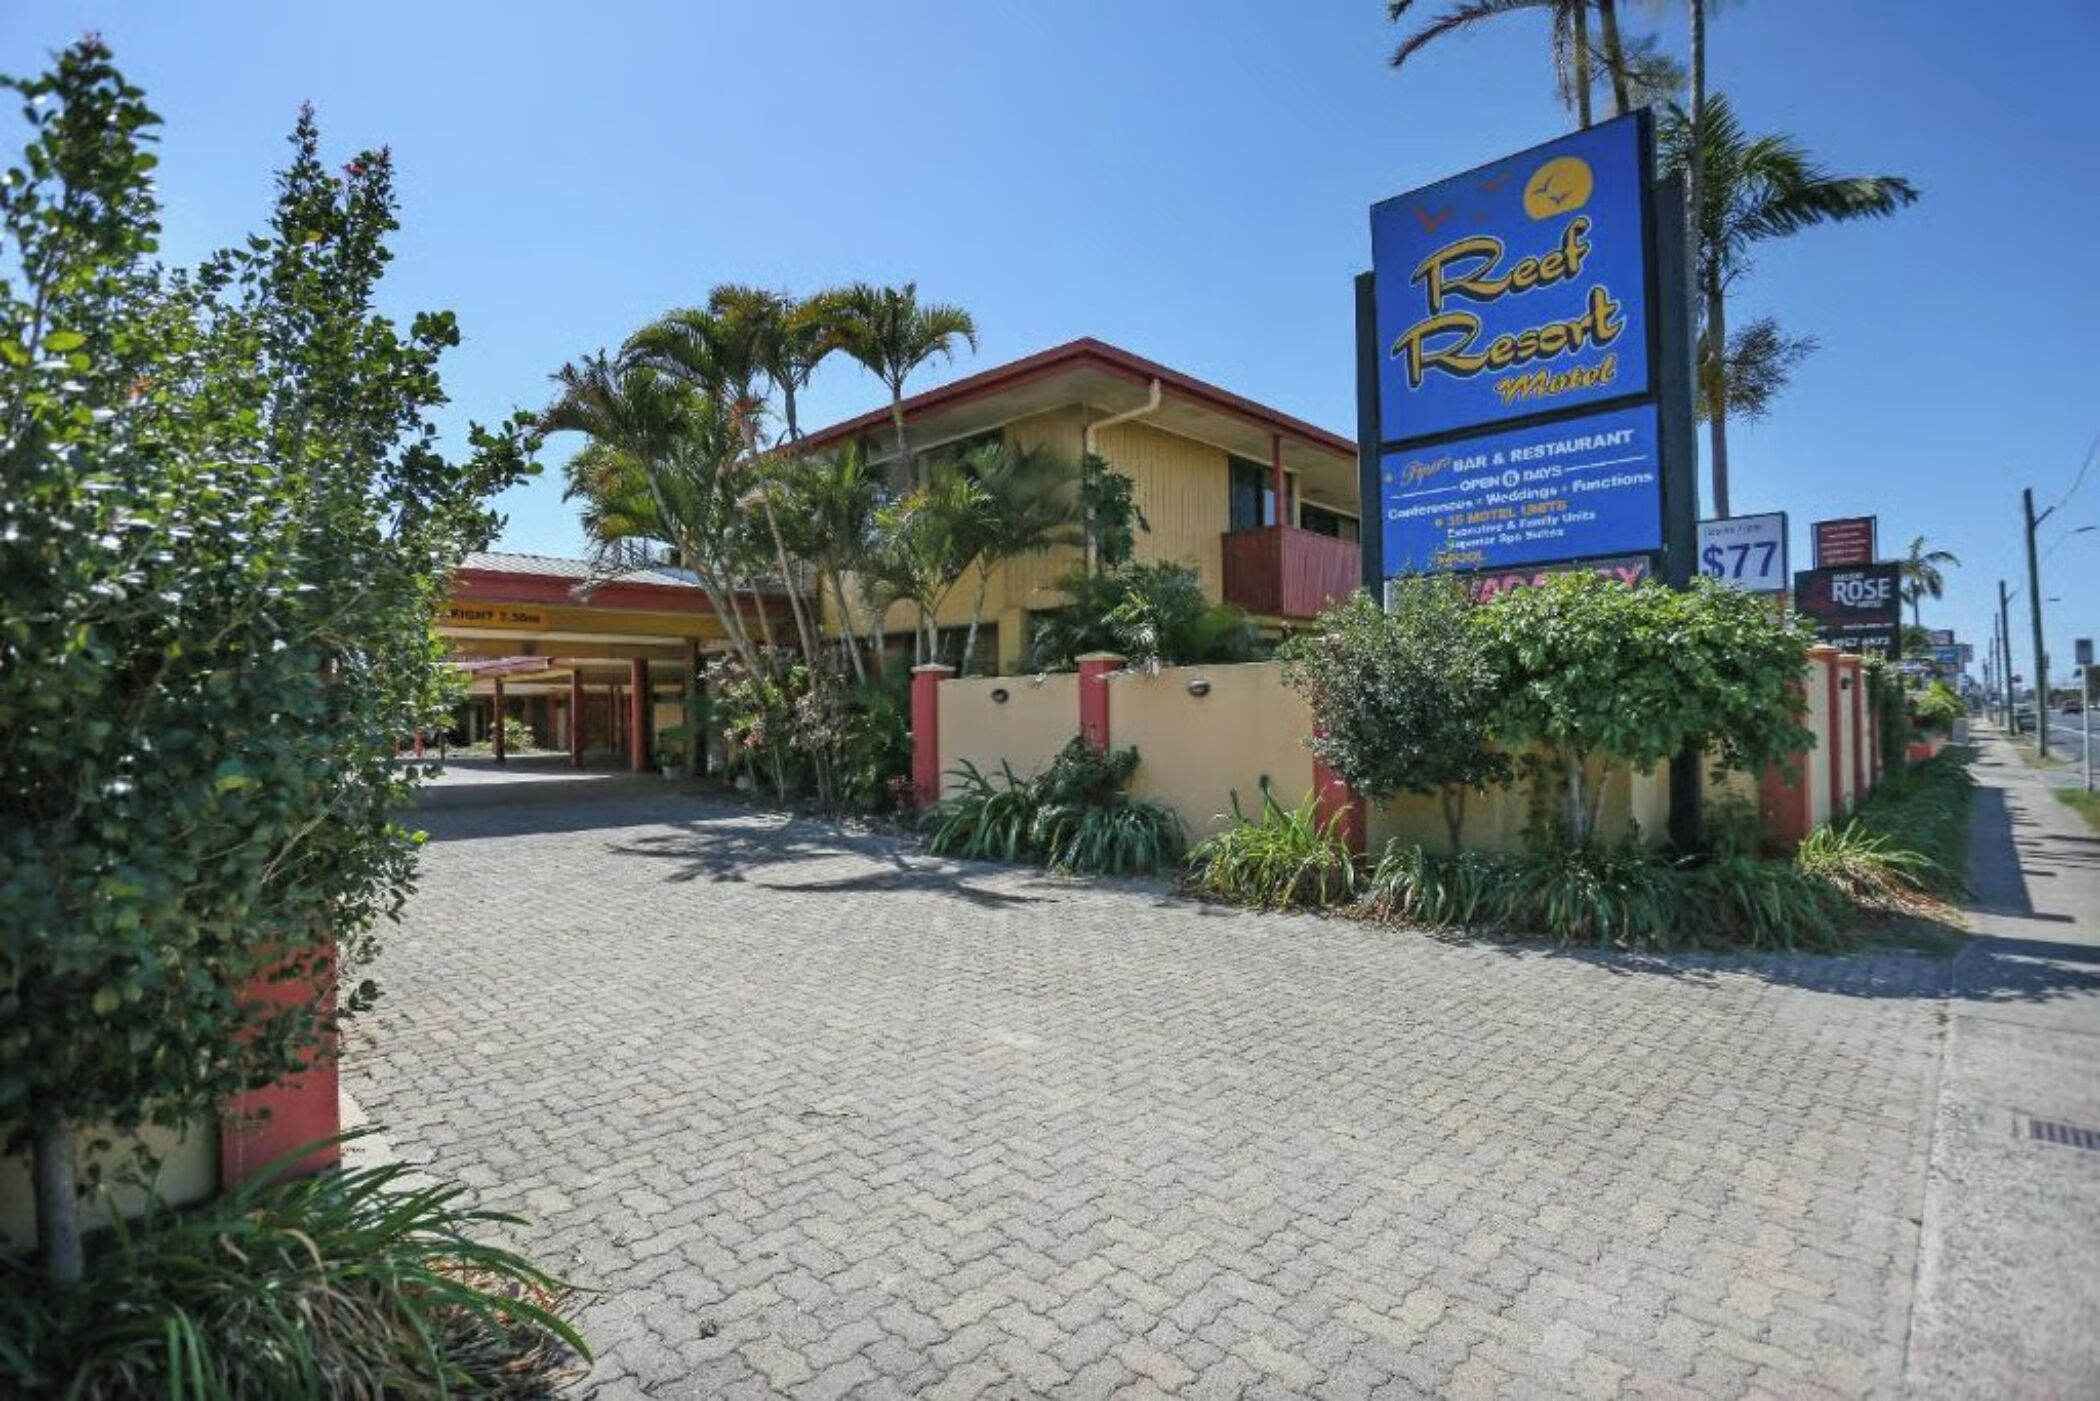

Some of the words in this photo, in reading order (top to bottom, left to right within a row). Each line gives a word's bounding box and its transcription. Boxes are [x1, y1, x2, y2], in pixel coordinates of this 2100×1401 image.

[1409, 216, 1591, 314] Reef
[1392, 286, 1625, 388] Resort
[1494, 355, 1617, 404] Motel
[1453, 454, 1487, 472] BAR
[1493, 453, 1505, 465] &
[1511, 429, 1635, 463] RESTAURANT
[1388, 499, 1473, 520] Conferences
[1486, 486, 1557, 505] Weddings
[1572, 472, 1653, 492] Functions
[1460, 475, 1499, 491] OPEN
[1522, 465, 1562, 482] DAYS
[1447, 523, 1503, 538] Executive
[1506, 520, 1516, 530] &
[1519, 513, 1558, 529] Family
[1562, 511, 1596, 523] Units
[1468, 508, 1516, 524] MOTEL
[1499, 532, 1522, 545] Spa
[1525, 528, 1565, 541] Suites
[1702, 541, 1778, 579] $77
[1832, 577, 1892, 607] ROSE
